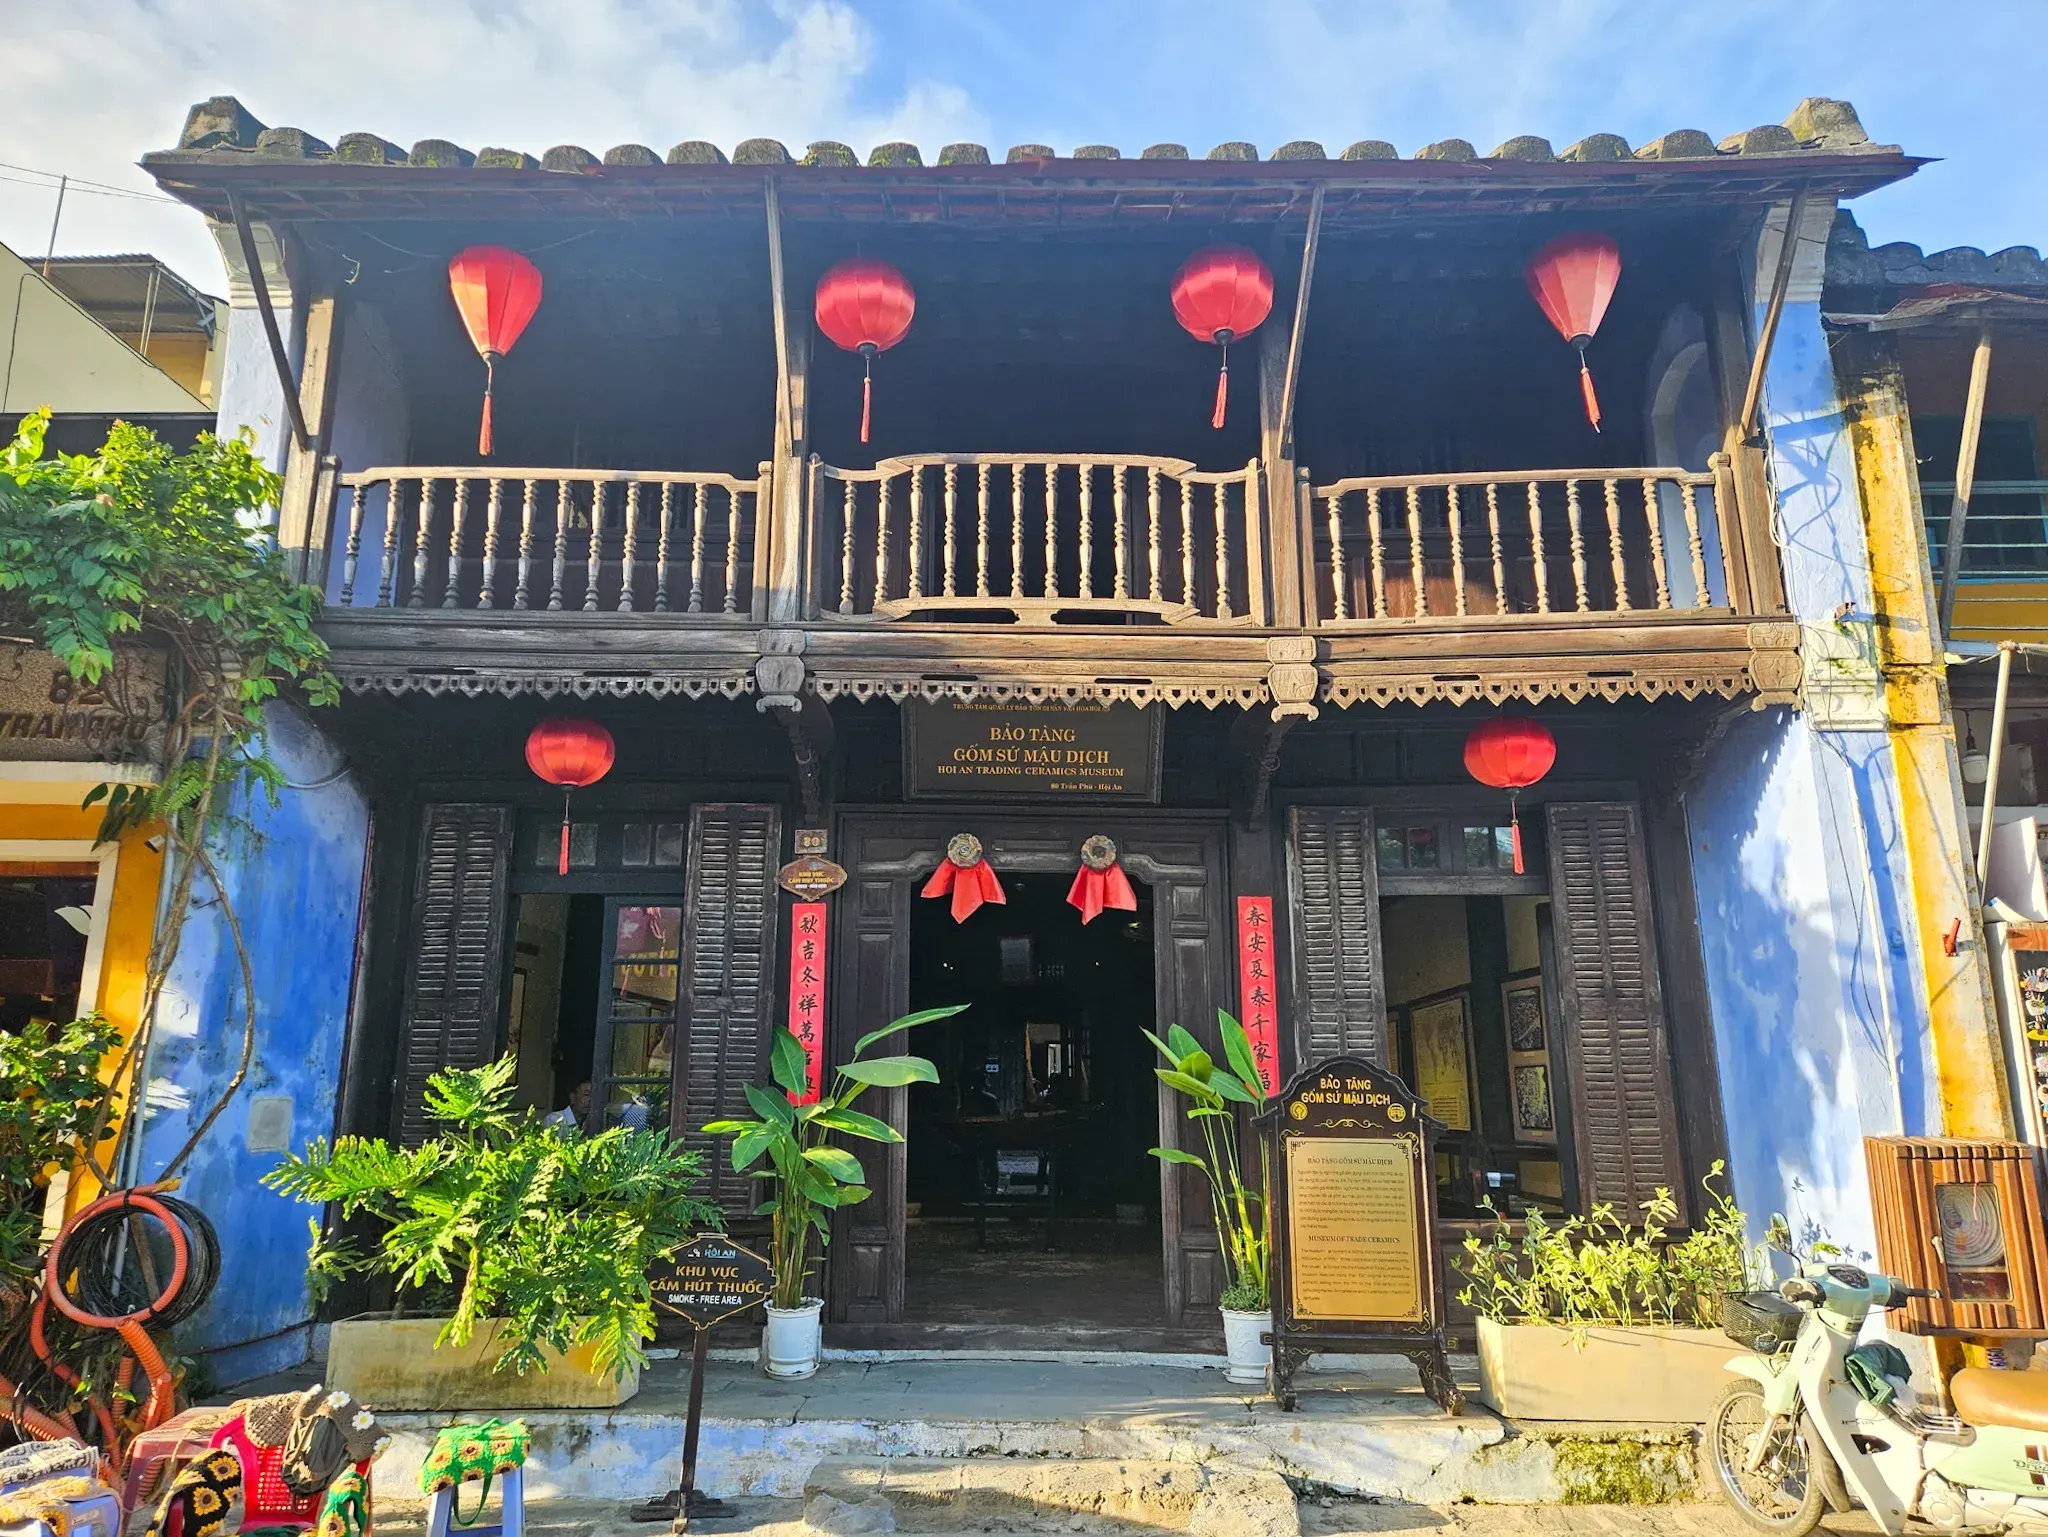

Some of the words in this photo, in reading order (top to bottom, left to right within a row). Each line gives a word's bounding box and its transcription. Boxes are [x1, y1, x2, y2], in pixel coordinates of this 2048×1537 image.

[990, 722, 1026, 741] BẢO
[1029, 724, 1076, 743] TÀNG
[953, 743, 993, 762] GỐM
[996, 745, 1020, 763] SỨ
[1023, 746, 1061, 766] MẬU
[1065, 750, 1110, 766] DỊCH
[959, 766, 973, 774] AN
[975, 766, 1021, 775] TRADING
[1025, 767, 1077, 776] CERAMICS
[1079, 768, 1124, 777] MUSEUM
[1320, 1074, 1341, 1090] BẢO
[1301, 1088, 1325, 1103] GỐM
[1326, 1090, 1342, 1104] SỨ
[1343, 1091, 1364, 1107] MẬU
[1365, 1093, 1391, 1108] DỊCH
[1346, 1235, 1367, 1243] TRADE
[1367, 1236, 1400, 1244] CERAMICS
[722, 1249, 736, 1258] AN
[675, 1265, 706, 1277] KHU
[711, 1266, 739, 1280] VỰC
[649, 1276, 679, 1291] CẤM
[684, 1278, 713, 1292] HÚT
[717, 1278, 764, 1294] THUỐC
[668, 1294, 695, 1304] SMOKE
[700, 1294, 719, 1304] FREE
[721, 1295, 742, 1305] AREA
